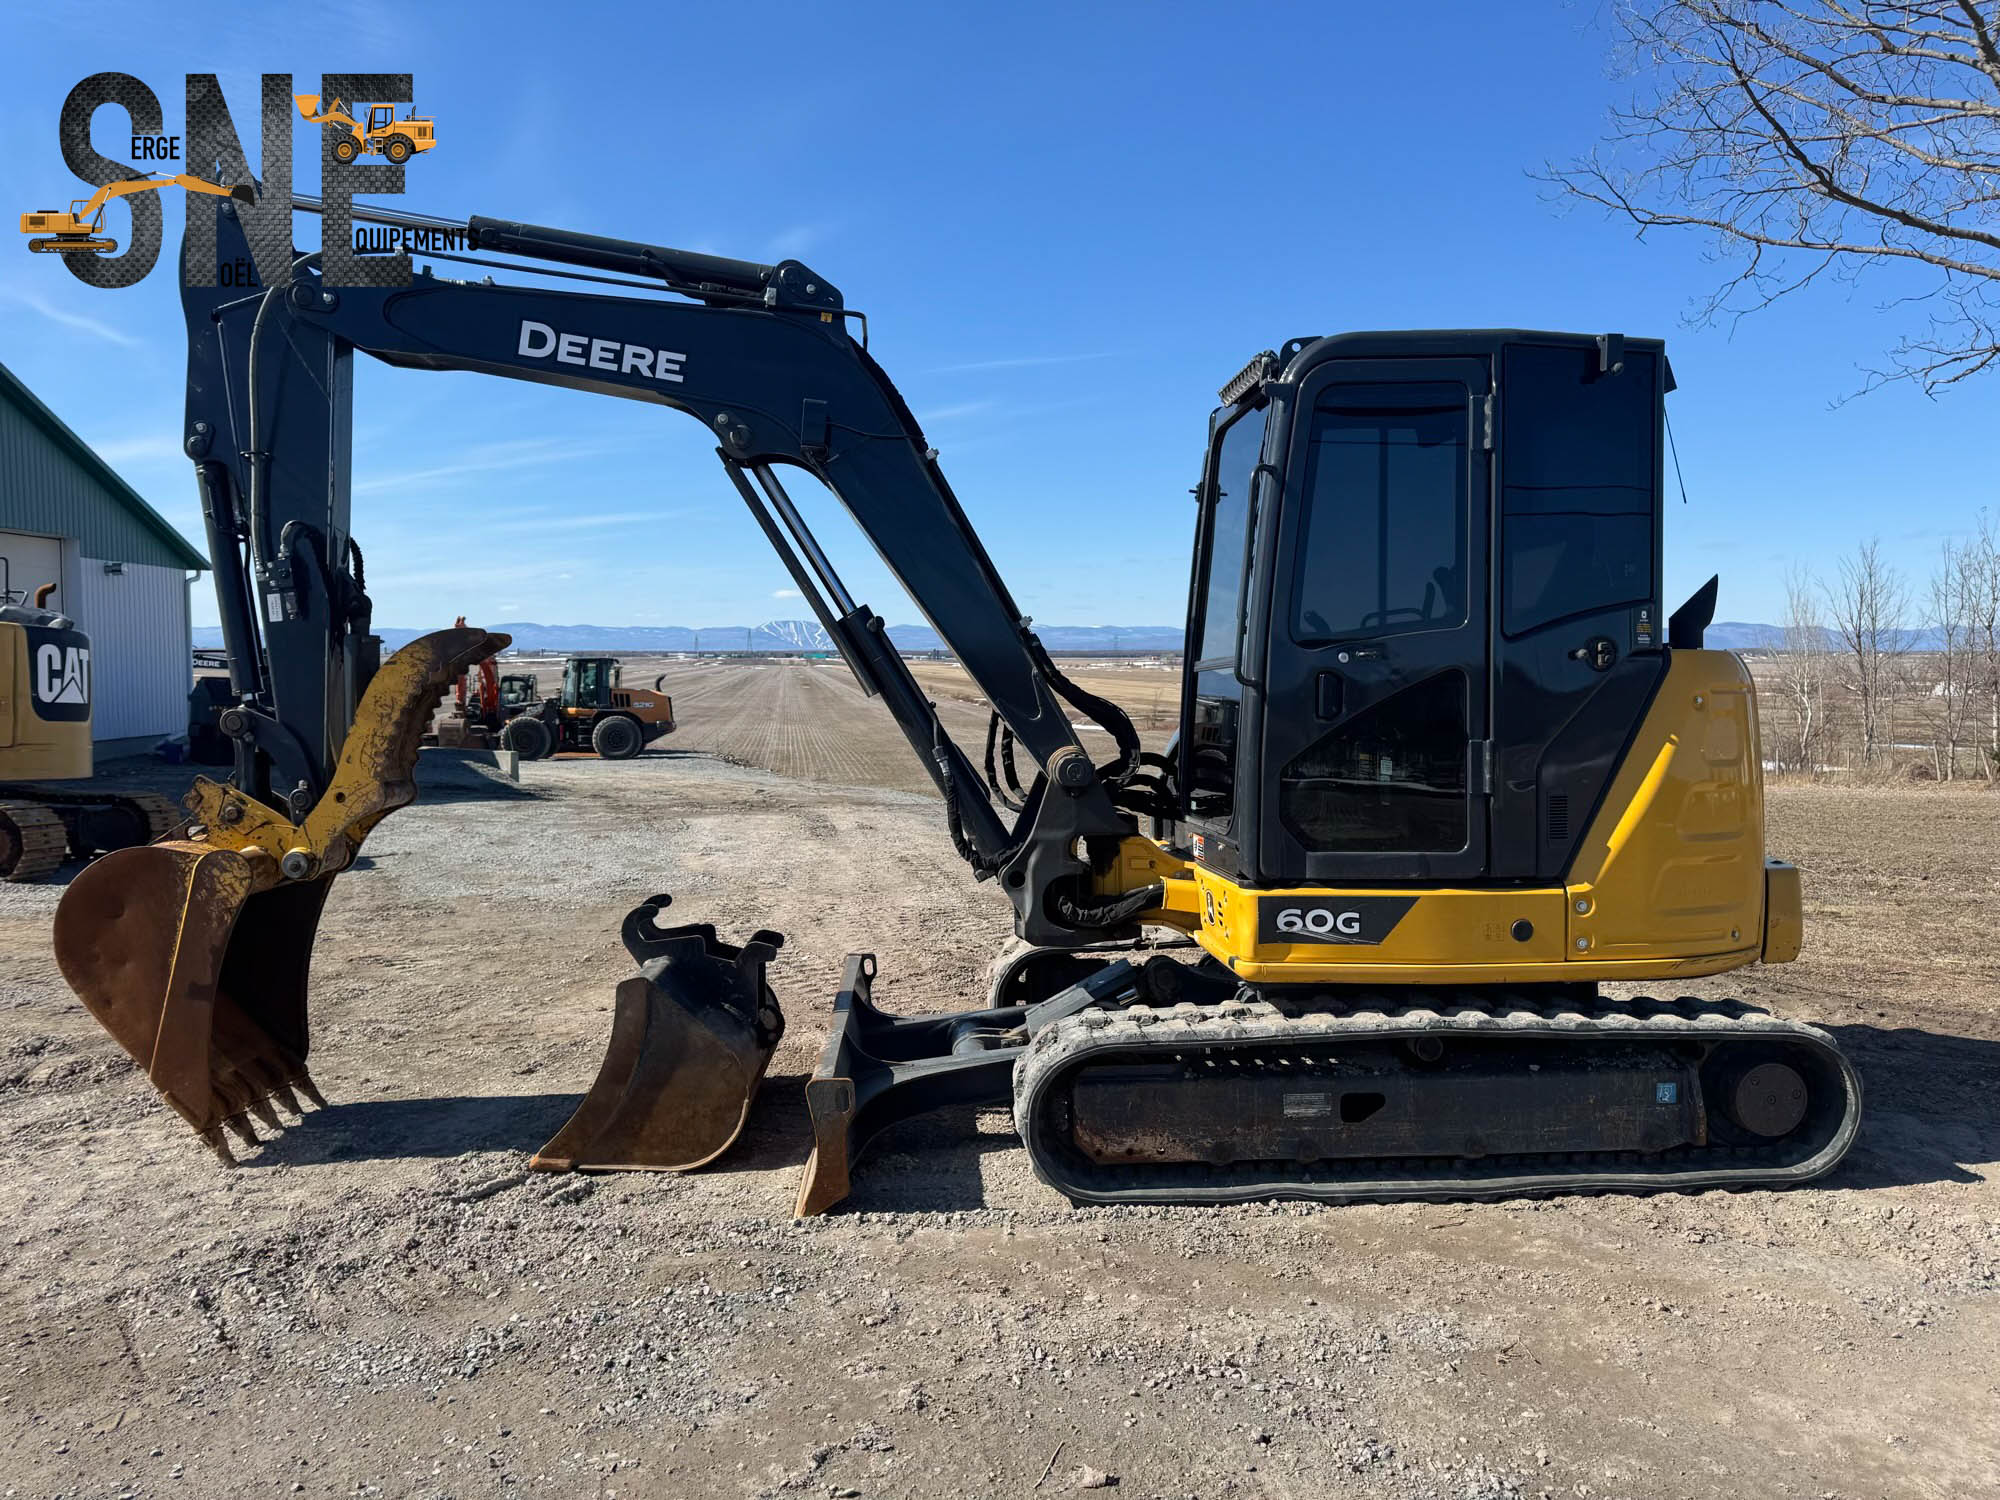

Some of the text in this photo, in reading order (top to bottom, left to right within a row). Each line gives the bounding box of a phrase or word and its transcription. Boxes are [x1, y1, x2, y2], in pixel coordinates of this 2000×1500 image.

[518, 320, 687, 383] DEERE
[37, 643, 89, 704] CAT
[193, 658, 221, 668] DEERE
[1276, 908, 1360, 934] 60G
